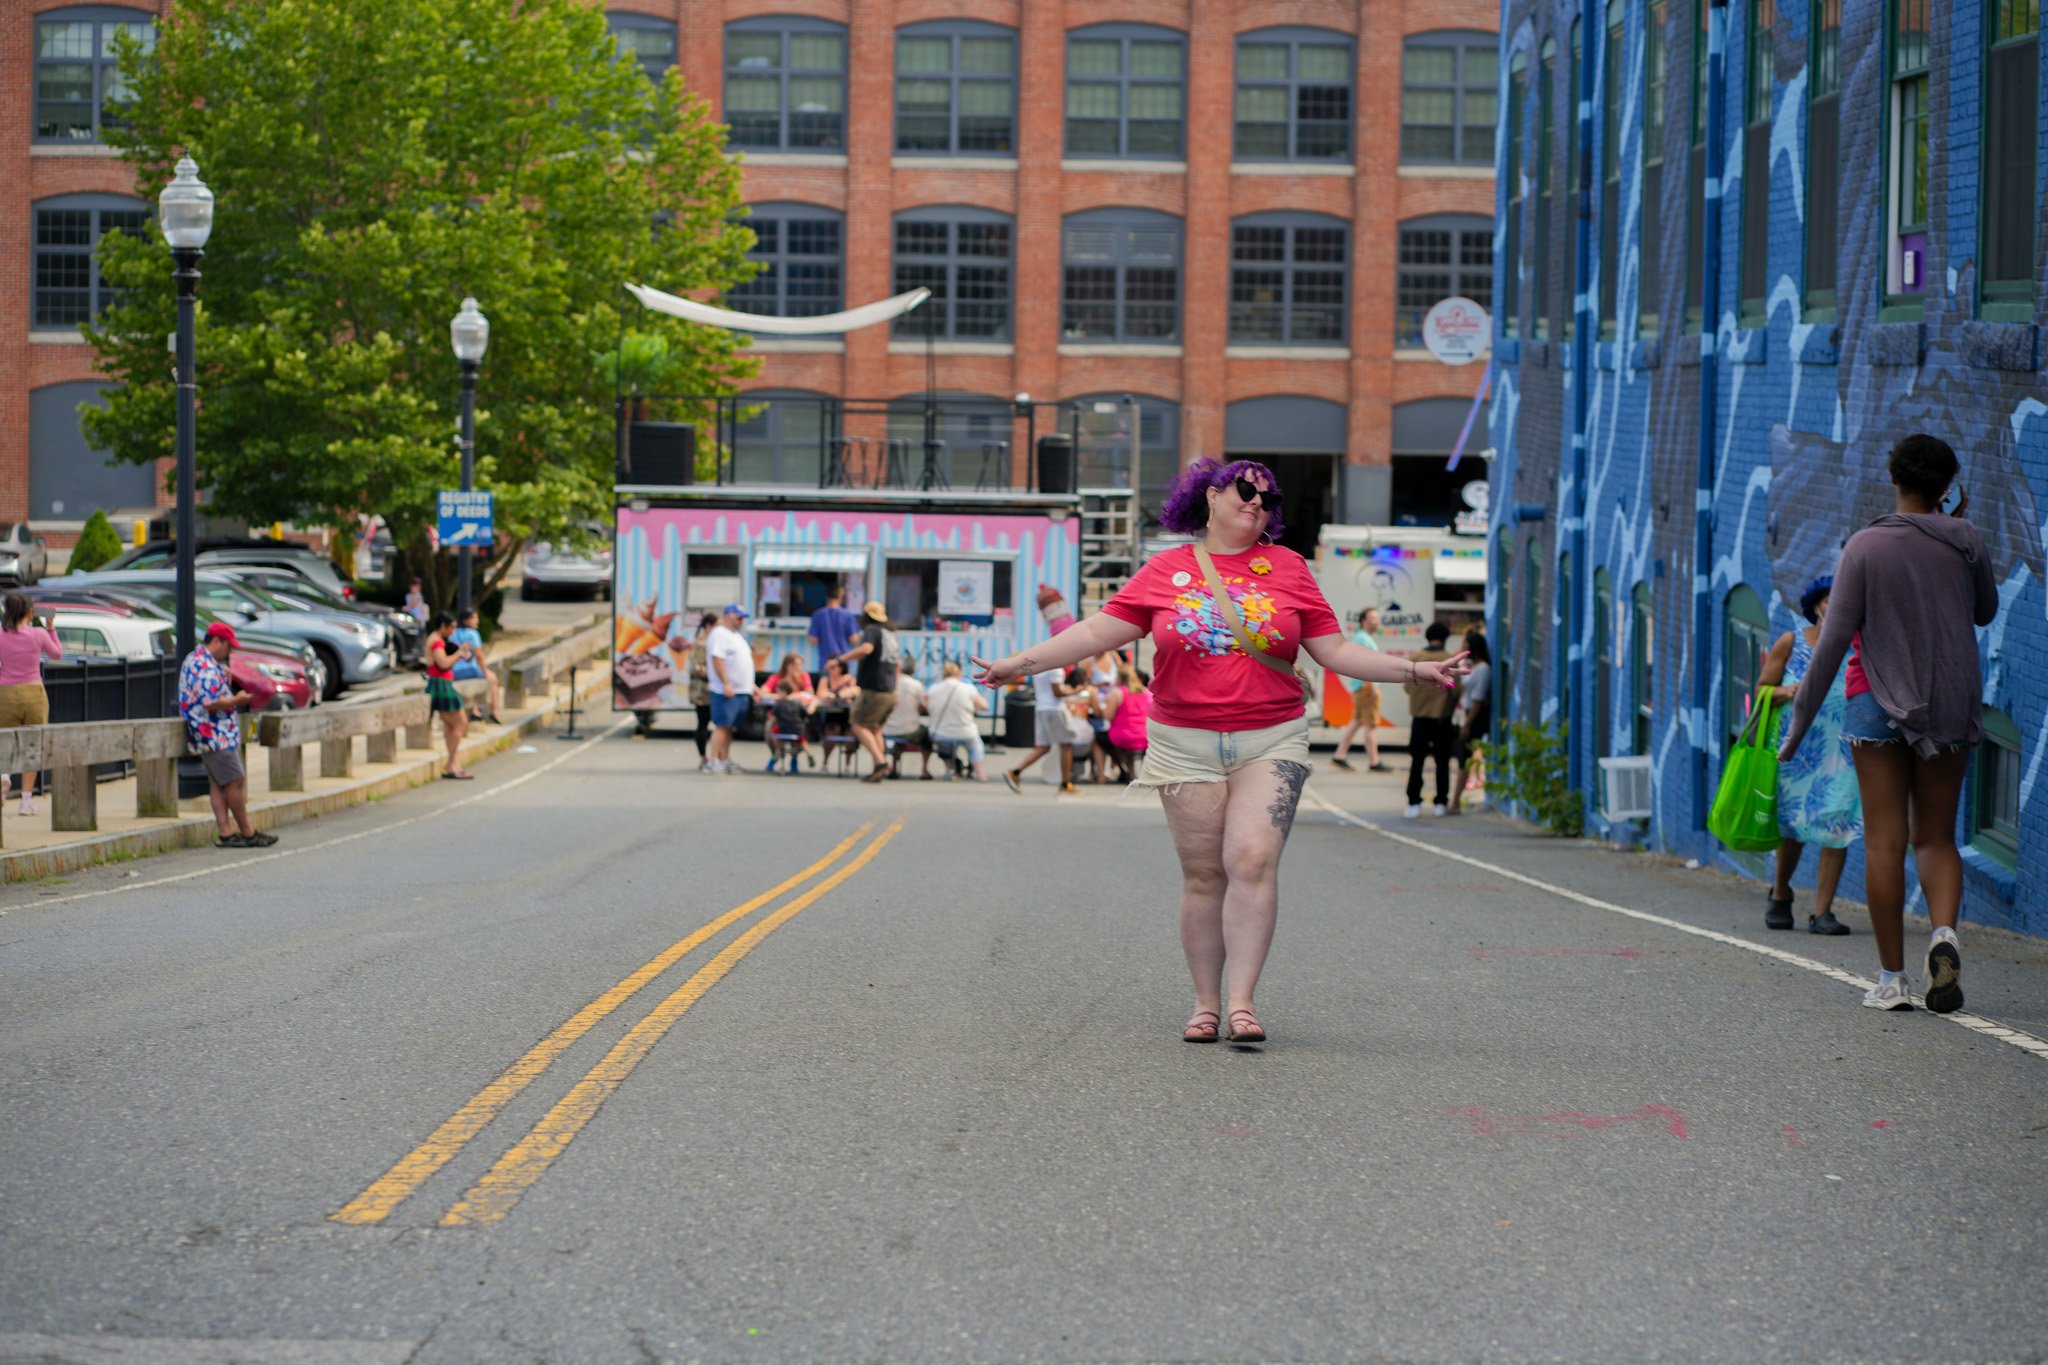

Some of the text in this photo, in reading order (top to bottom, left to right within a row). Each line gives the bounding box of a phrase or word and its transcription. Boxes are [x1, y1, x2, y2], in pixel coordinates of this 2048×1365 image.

[440, 491, 491, 504] REGISTRY
[440, 504, 491, 518] OF DEEDS
